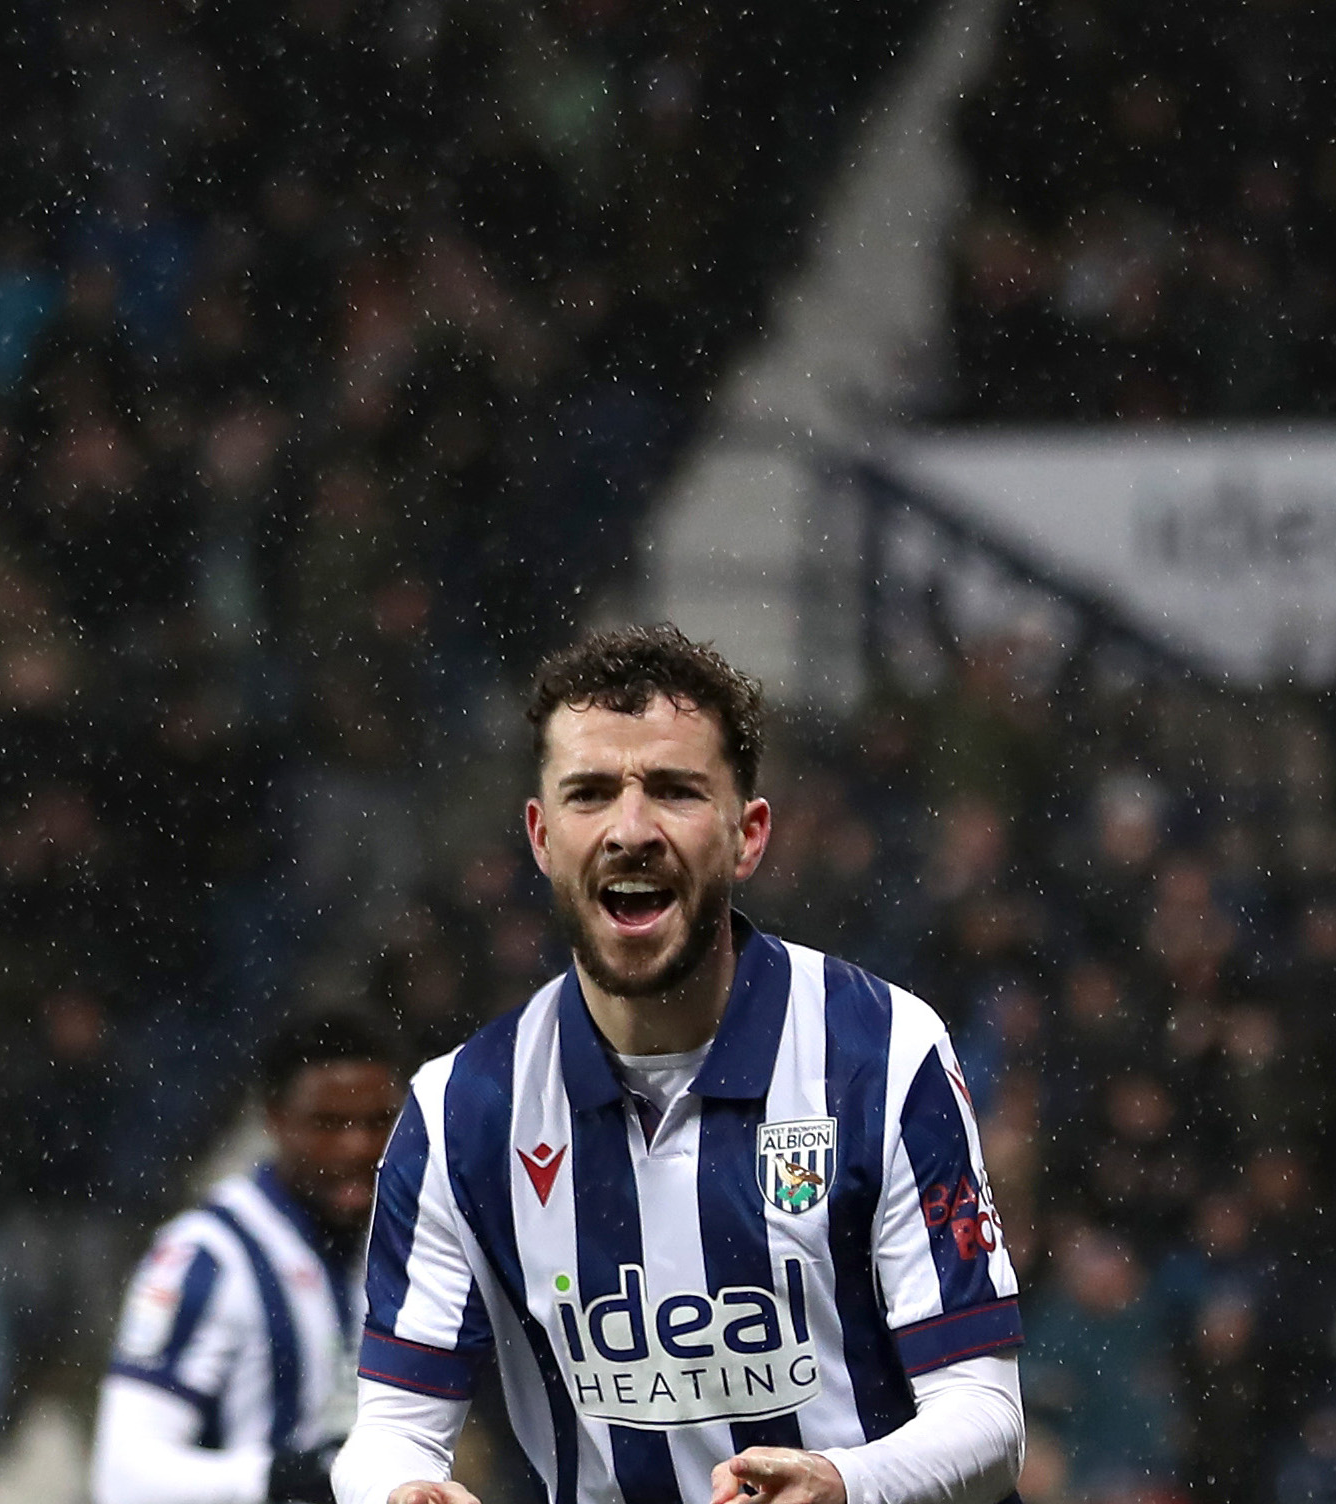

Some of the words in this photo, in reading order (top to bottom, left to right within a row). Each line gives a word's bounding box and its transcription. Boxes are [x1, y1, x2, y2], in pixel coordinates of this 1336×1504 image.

[764, 1132, 830, 1150] ALBION
[554, 1259, 810, 1362] ideal
[574, 1355, 818, 1405] HEATING
